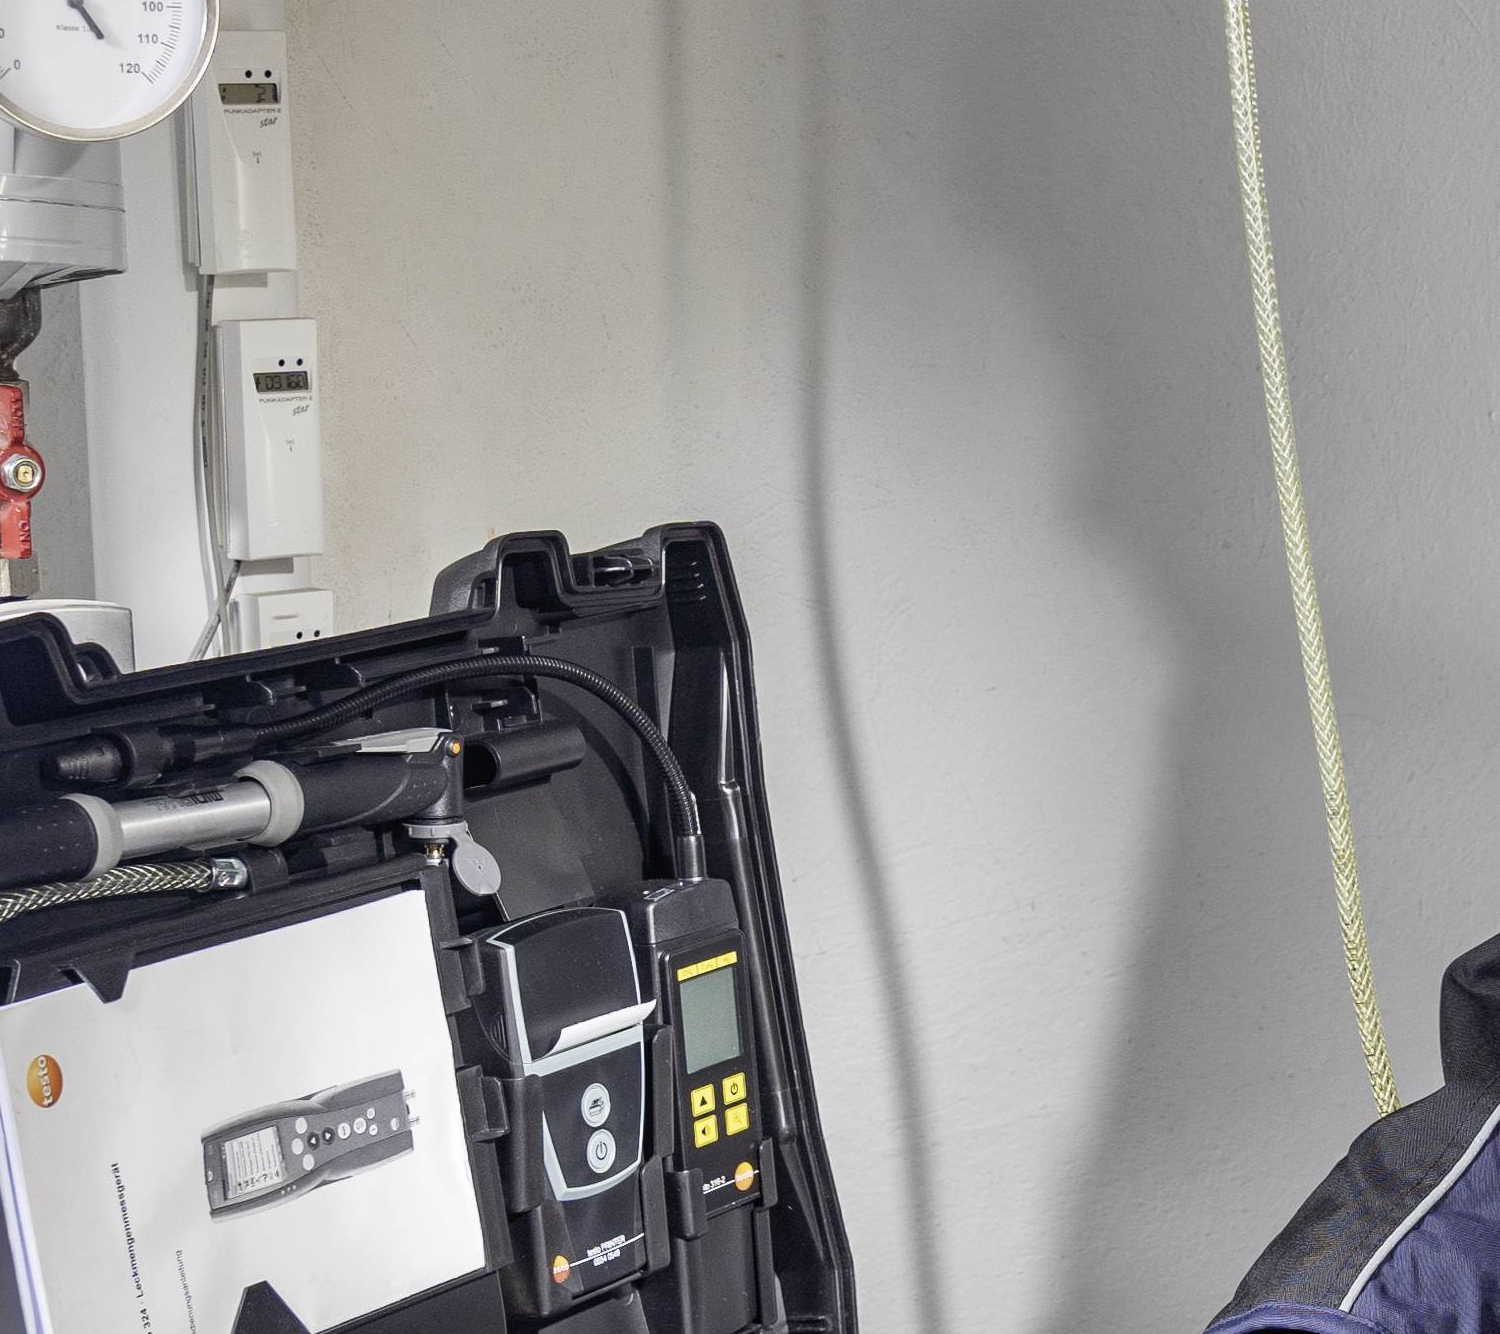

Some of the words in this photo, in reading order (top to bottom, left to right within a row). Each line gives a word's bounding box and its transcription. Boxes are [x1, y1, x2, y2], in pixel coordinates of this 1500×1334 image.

[142, 1, 164, 12] 100
[138, 34, 158, 44] 110
[13, 60, 22, 70] 0
[119, 63, 140, 74] 120
[260, 117, 278, 128] star
[37, 1056, 53, 1106] testo
[139, 1308, 151, 1330] 324
